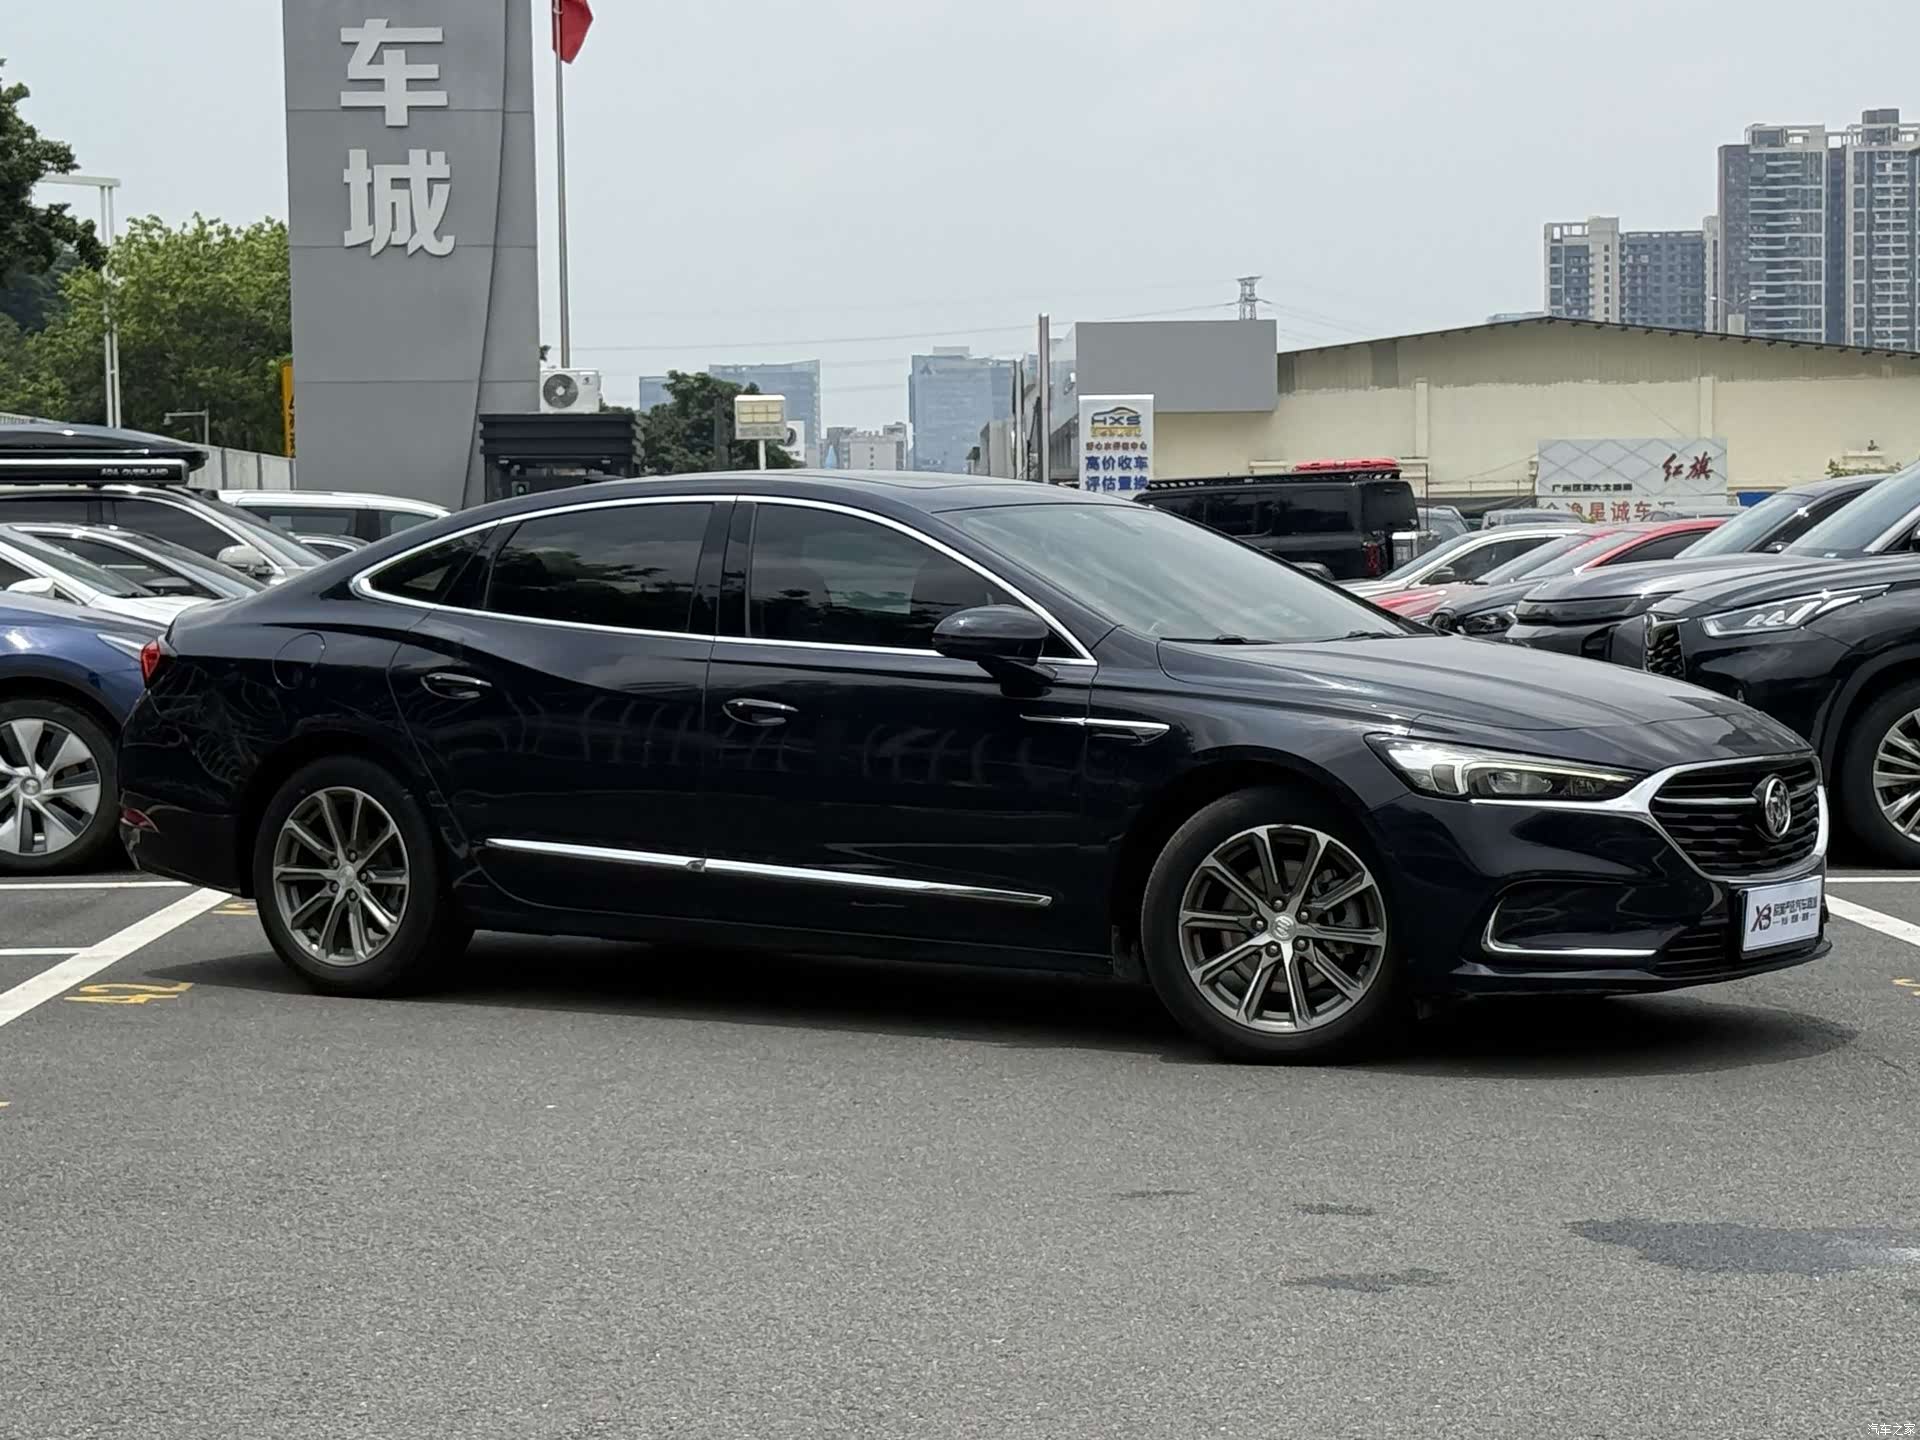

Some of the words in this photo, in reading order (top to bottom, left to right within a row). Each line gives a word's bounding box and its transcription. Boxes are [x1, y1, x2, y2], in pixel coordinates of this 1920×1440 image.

[340, 18, 456, 257] 车城
[1091, 414, 1142, 426] HXS
[1084, 455, 1149, 471] 高价收车
[1661, 451, 1713, 482] 红旗
[1084, 475, 1148, 492] 评估置换
